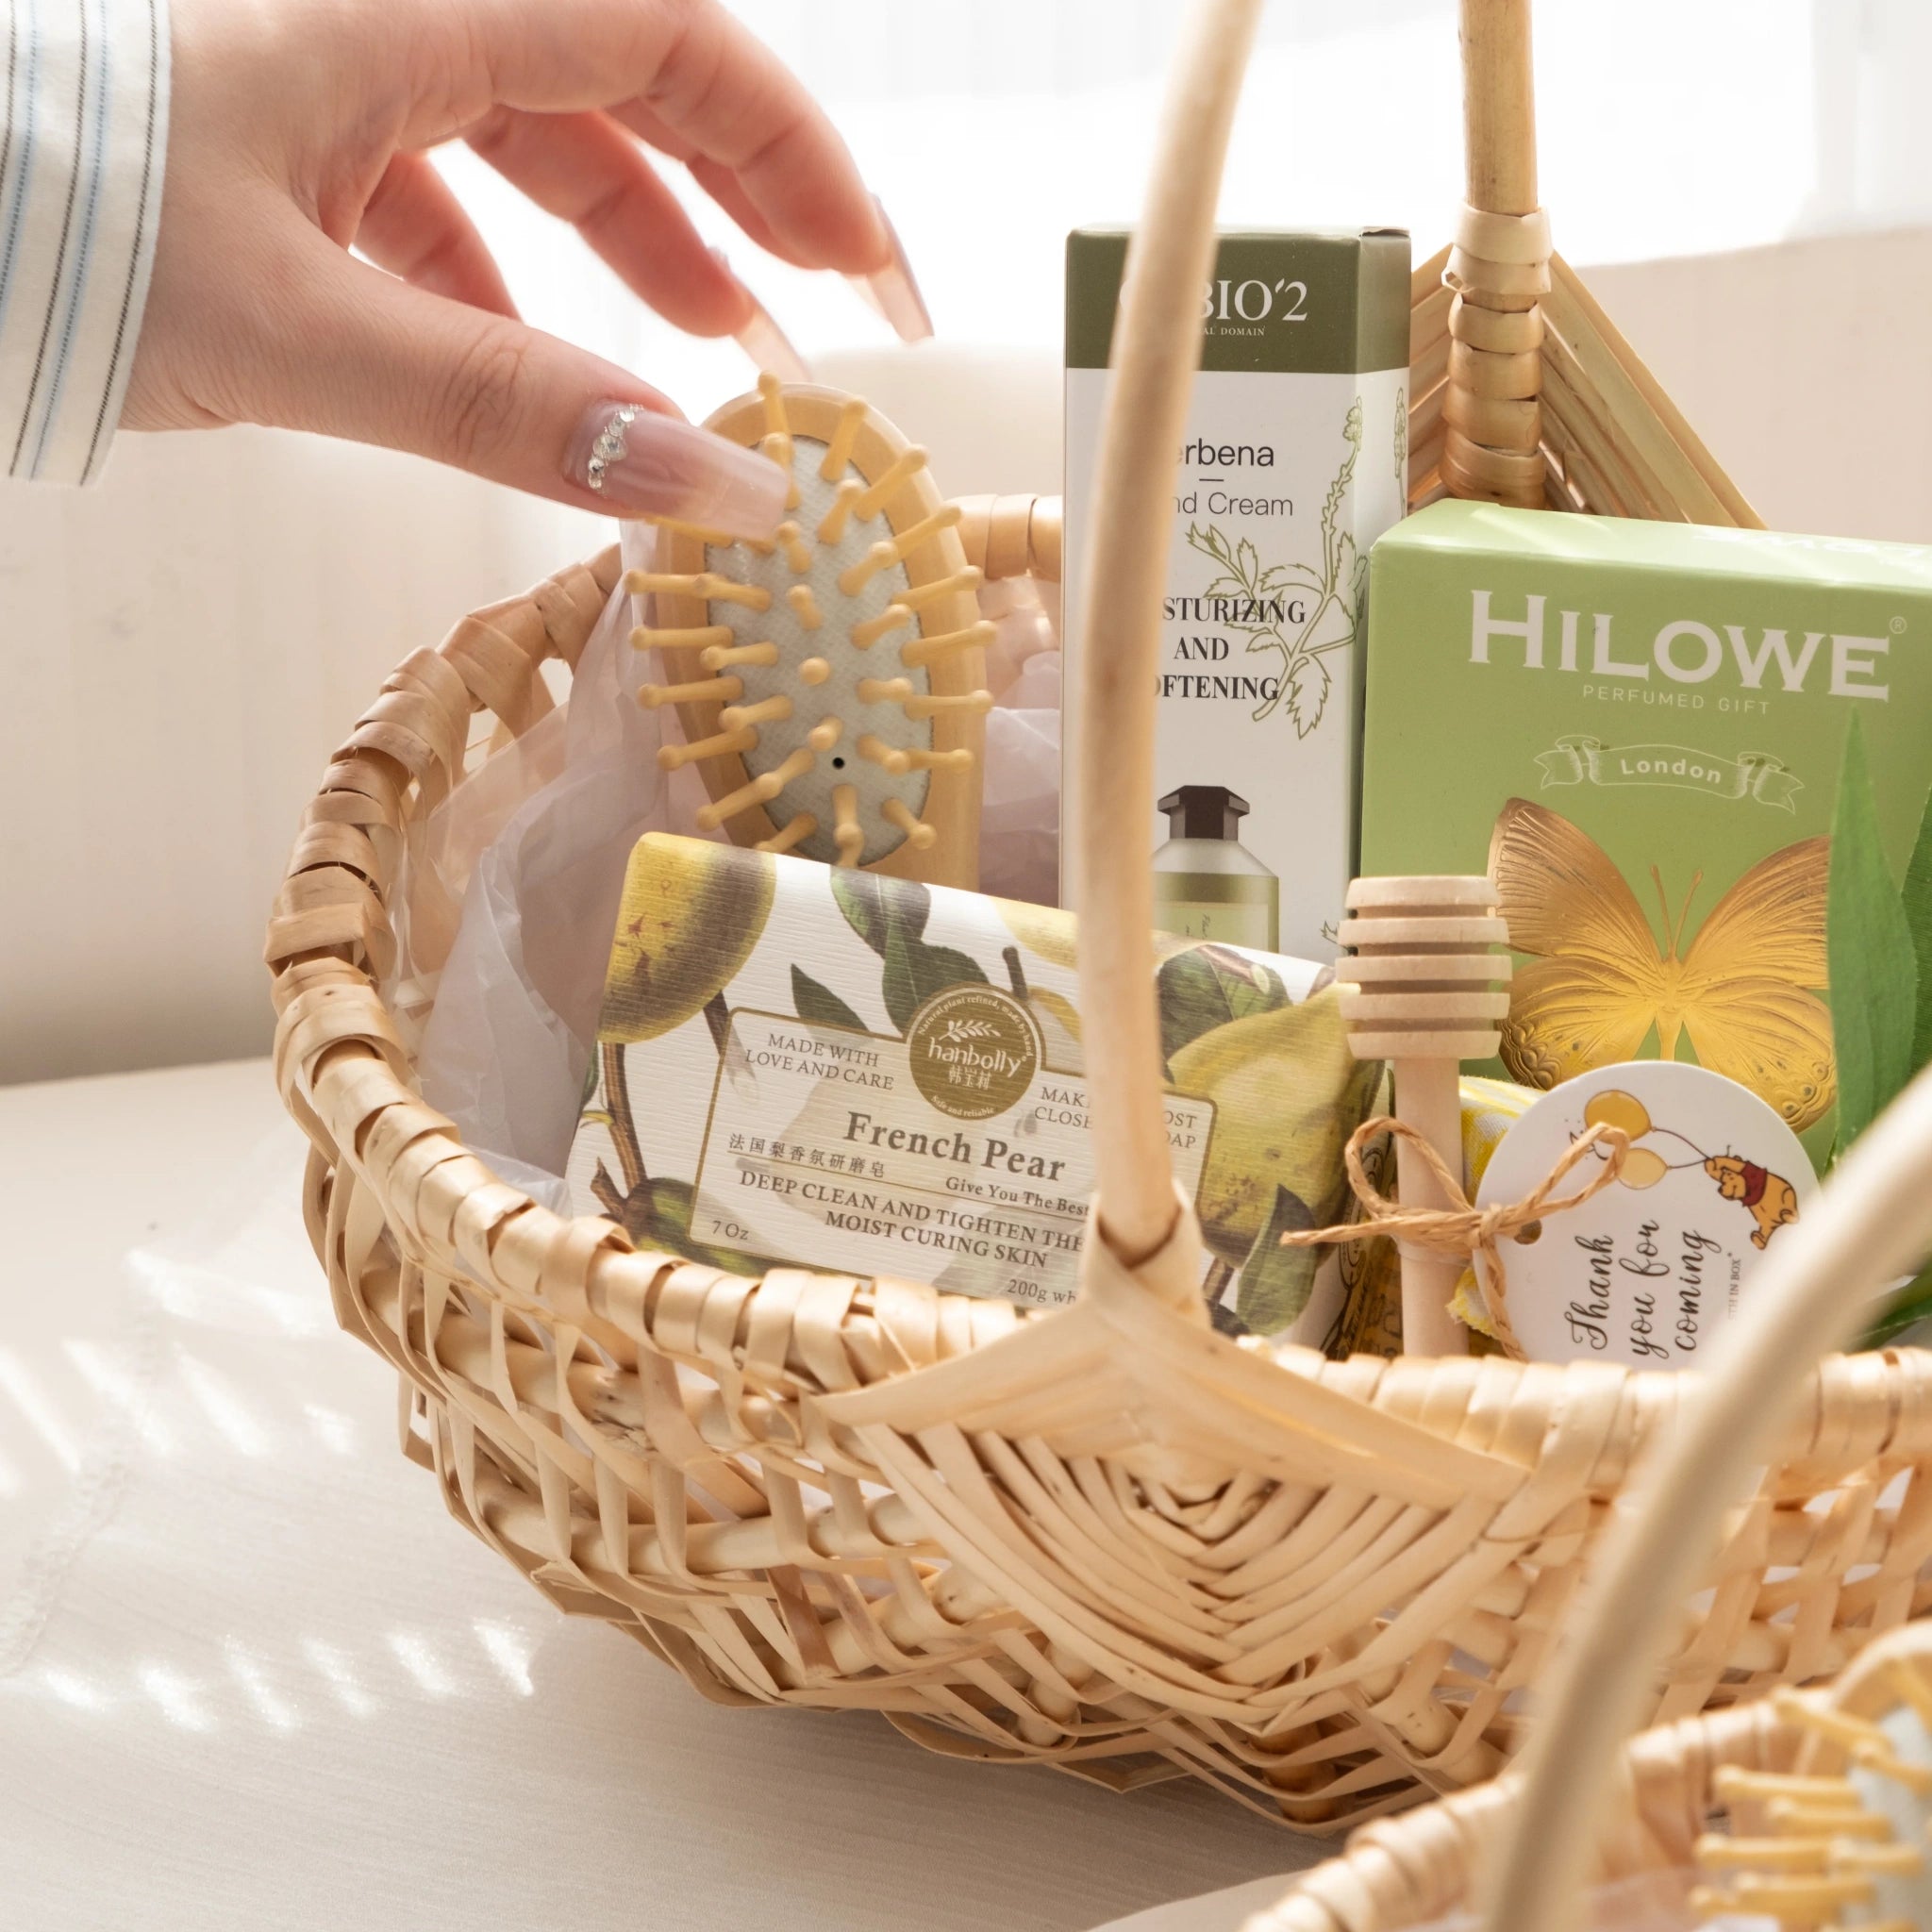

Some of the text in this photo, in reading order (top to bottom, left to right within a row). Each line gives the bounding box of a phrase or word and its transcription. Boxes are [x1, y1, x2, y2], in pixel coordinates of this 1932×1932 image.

[1221, 325, 1266, 337] DOMAIN
[1176, 438, 1274, 467] rbena
[1208, 491, 1293, 517] Cream
[1162, 597, 1307, 625] STURIZING
[1173, 636, 1230, 661] AND
[1469, 590, 1890, 703] HILOWE
[1157, 675, 1280, 701] FTENING
[1582, 685, 1771, 716] PERFUMED GIFT
[1619, 758, 1723, 785] London
[768, 1033, 879, 1068] MADE WITH
[744, 1049, 894, 1091] LOVE AND CARE
[1040, 1086, 1091, 1108] MAK
[728, 1132, 886, 1179] 法国梨香氛研磨皂
[842, 1110, 1067, 1182] French Pear
[739, 1170, 798, 1195] DEEP
[802, 1182, 878, 1211] CLEAN
[881, 1199, 931, 1223] AND
[936, 1208, 1037, 1243] TIGHTEN
[945, 1176, 983, 1196] Give
[988, 1184, 1019, 1202] You
[1023, 1191, 1053, 1210] The
[711, 1220, 750, 1241] 7 Oz
[824, 1210, 1049, 1269] MOIST CURING SKIN
[1007, 1278, 1048, 1303] 200g
[1562, 1234, 1615, 1351] Thank
[1617, 1219, 1672, 1360] you for
[1674, 1229, 1723, 1353] coming
[1728, 1283, 1740, 1296] IN
